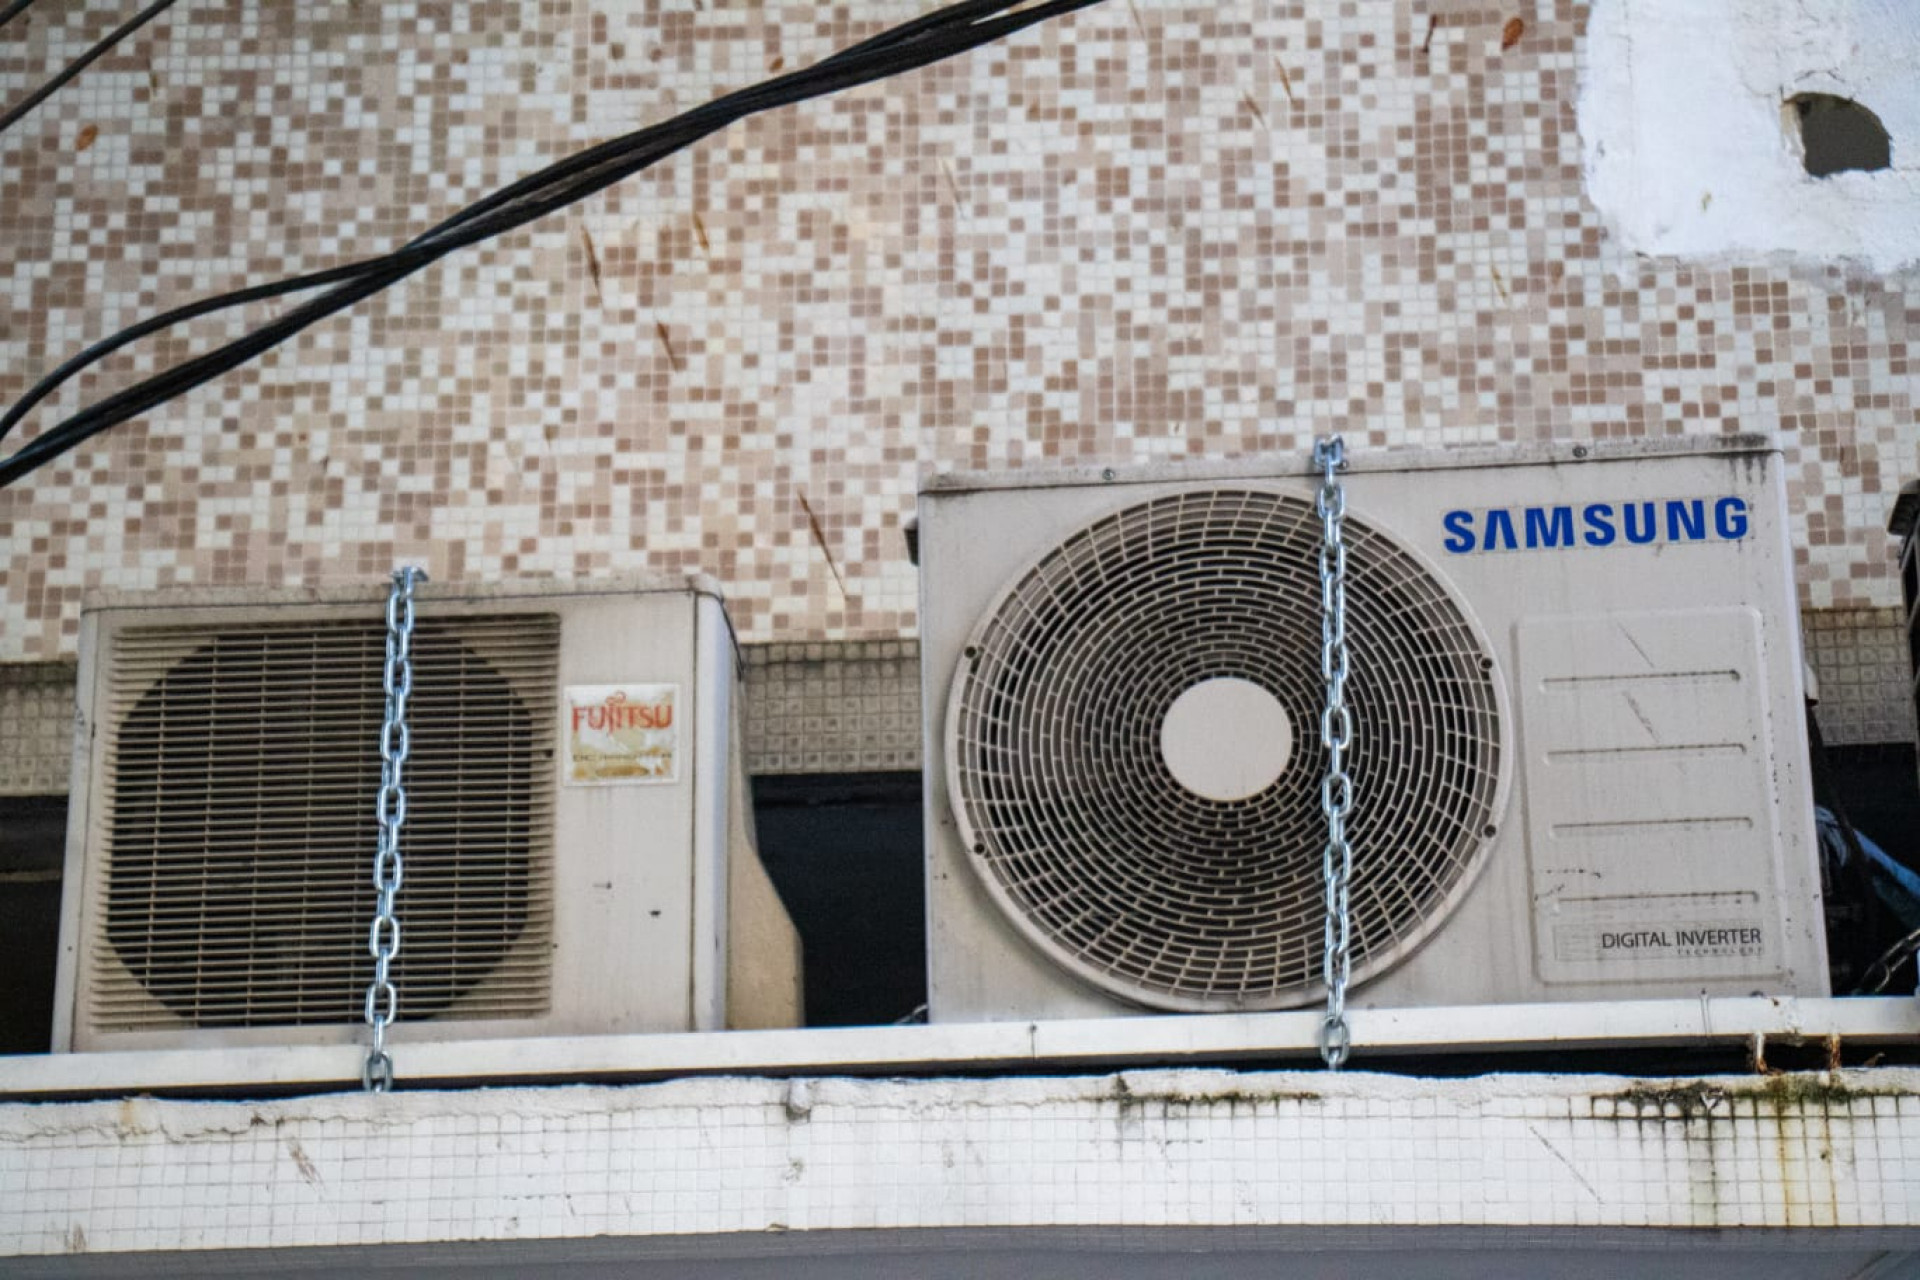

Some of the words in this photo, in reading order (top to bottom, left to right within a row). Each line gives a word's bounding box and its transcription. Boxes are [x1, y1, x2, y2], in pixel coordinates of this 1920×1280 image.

[1443, 496, 1748, 553] SAMSUNG
[572, 698, 672, 734] FUJITSU
[1602, 932, 1671, 949] DIGITAL
[1676, 928, 1761, 946] INVERTER
